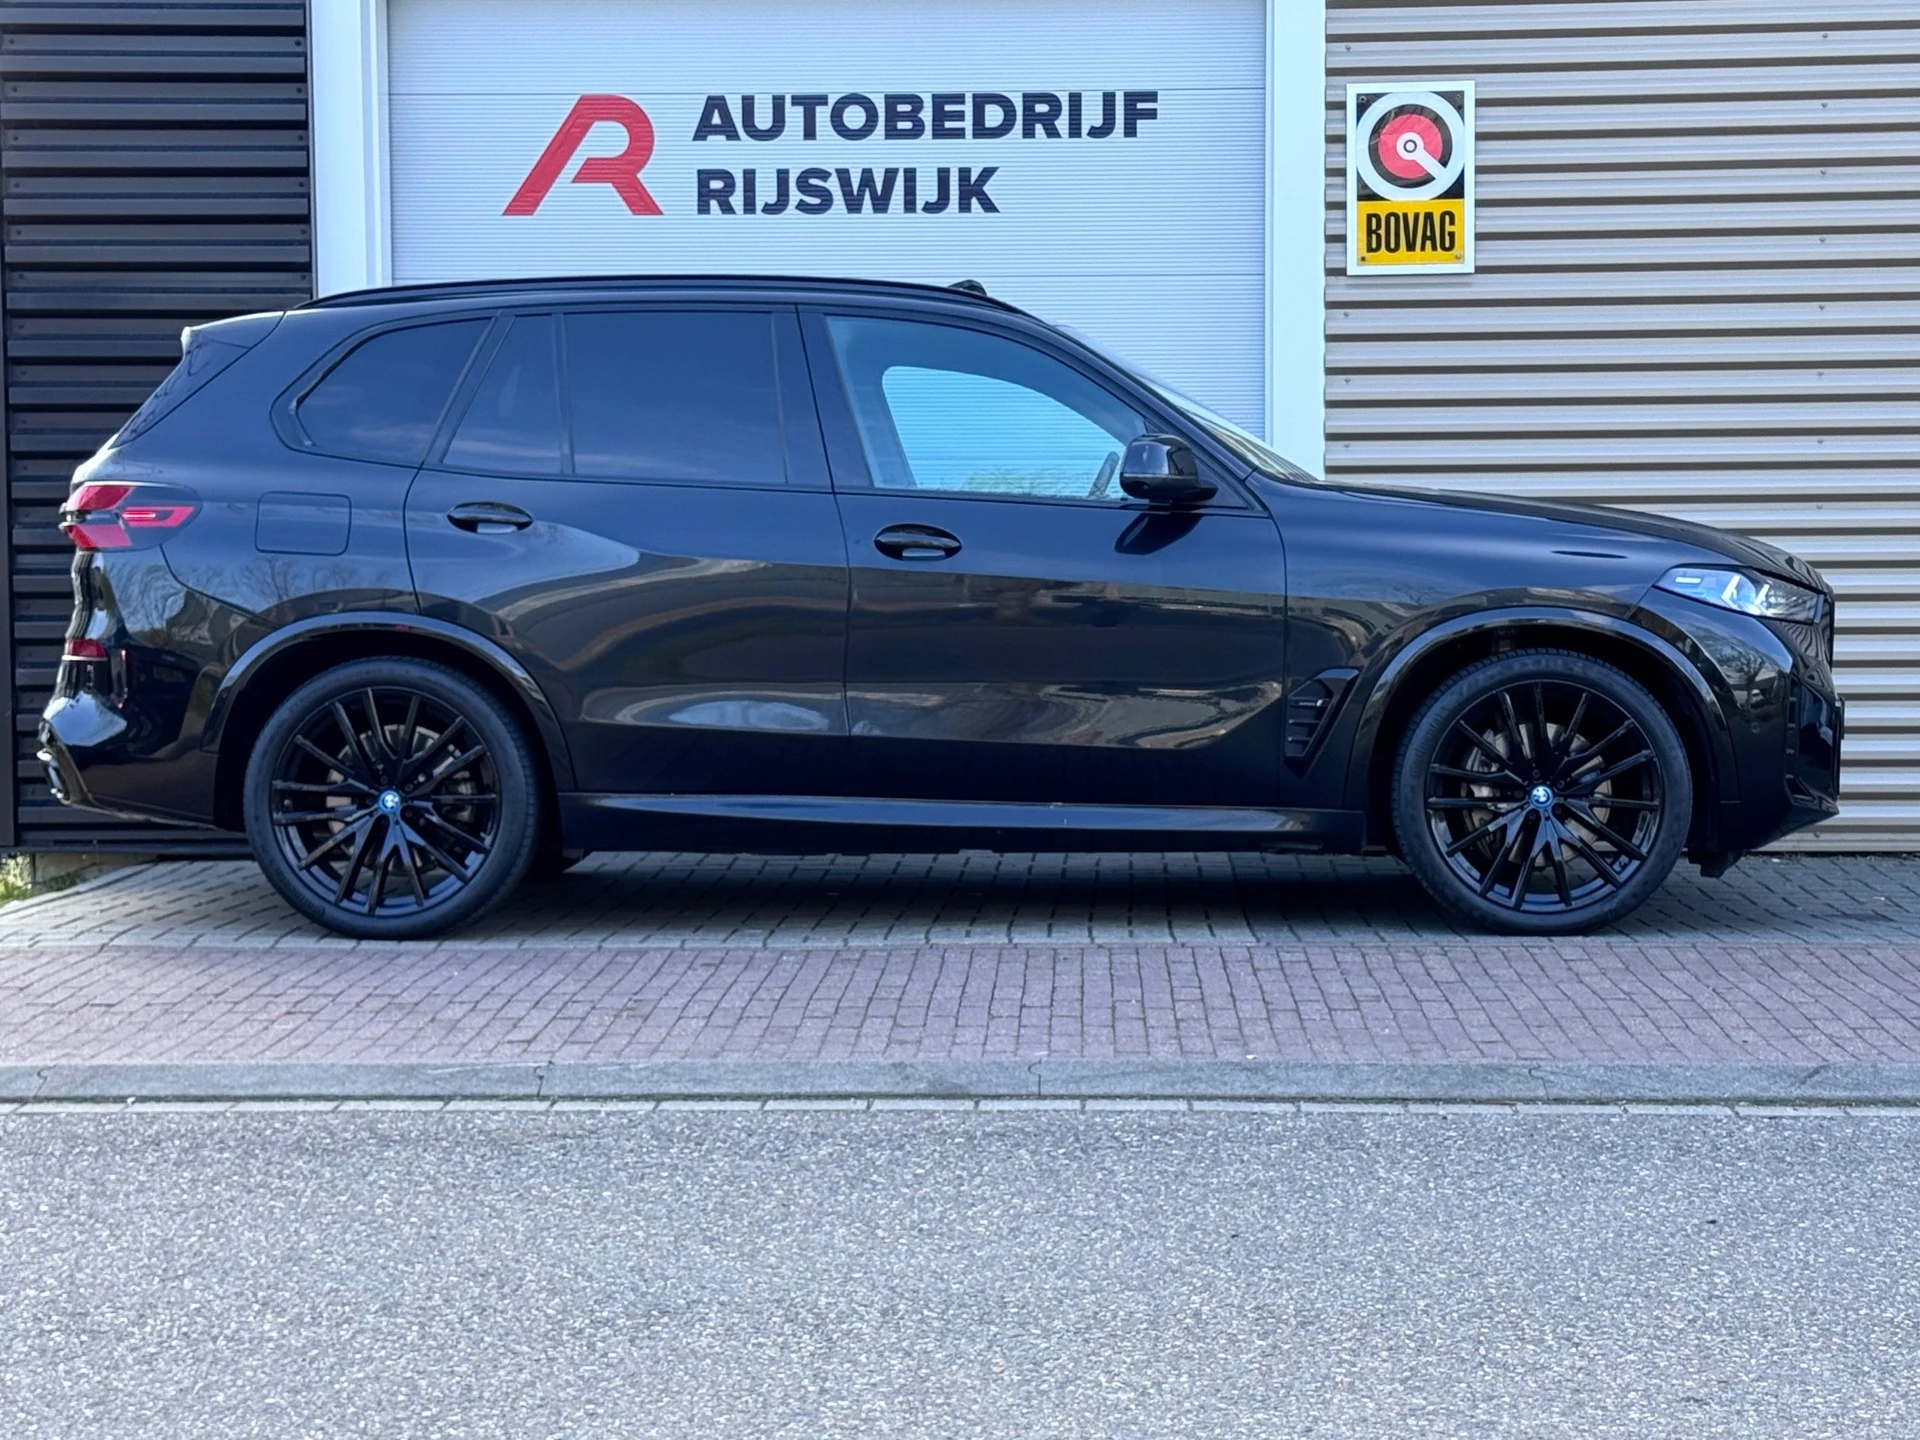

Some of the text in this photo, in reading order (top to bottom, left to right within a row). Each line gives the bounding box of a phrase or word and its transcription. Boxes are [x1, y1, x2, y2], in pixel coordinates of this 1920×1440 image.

[692, 91, 1159, 142] AUTOBEDRIJF
[696, 167, 1000, 215] RIJSWIJK
[1366, 211, 1456, 254] BOVAG
